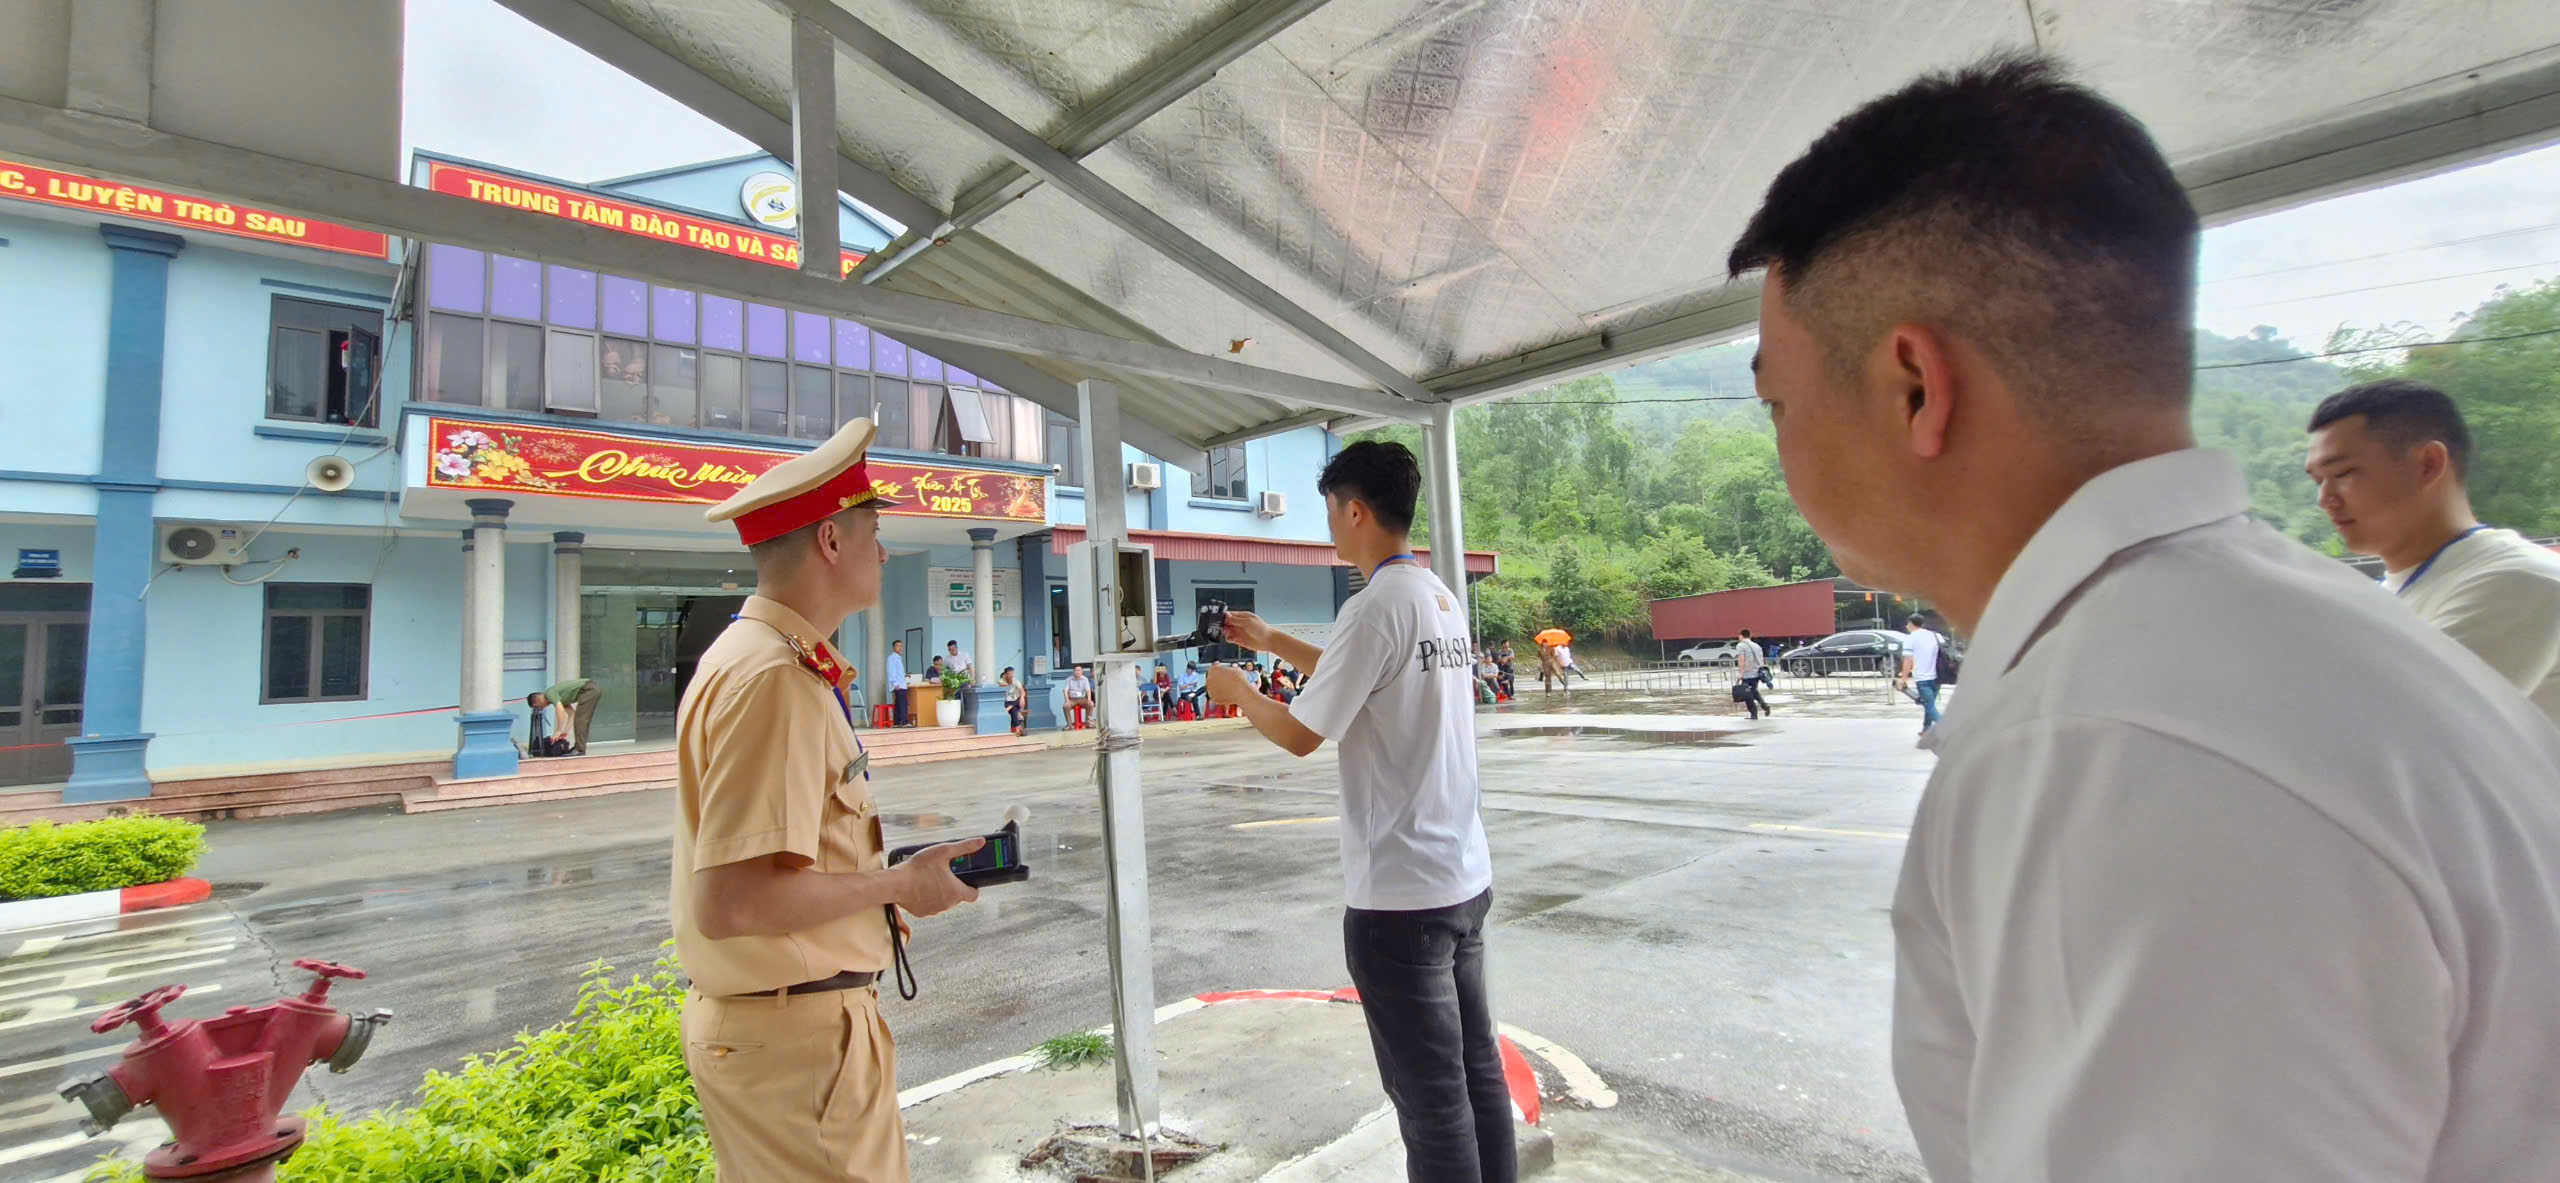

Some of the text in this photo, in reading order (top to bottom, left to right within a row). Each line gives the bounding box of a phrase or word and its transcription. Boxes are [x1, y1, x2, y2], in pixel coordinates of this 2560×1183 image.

[49, 178, 163, 213] LUYỆN
[173, 200, 236, 226] TRÒ
[245, 213, 306, 237] SAU
[467, 178, 560, 214] TRUNG
[568, 201, 624, 227] TÂM
[631, 214, 680, 239] ĐÀO
[687, 225, 730, 249] TẠO
[736, 234, 765, 257] VÀ
[542, 450, 703, 488] Chúc
[689, 462, 758, 491] Mừn
[931, 495, 972, 512] 2025
